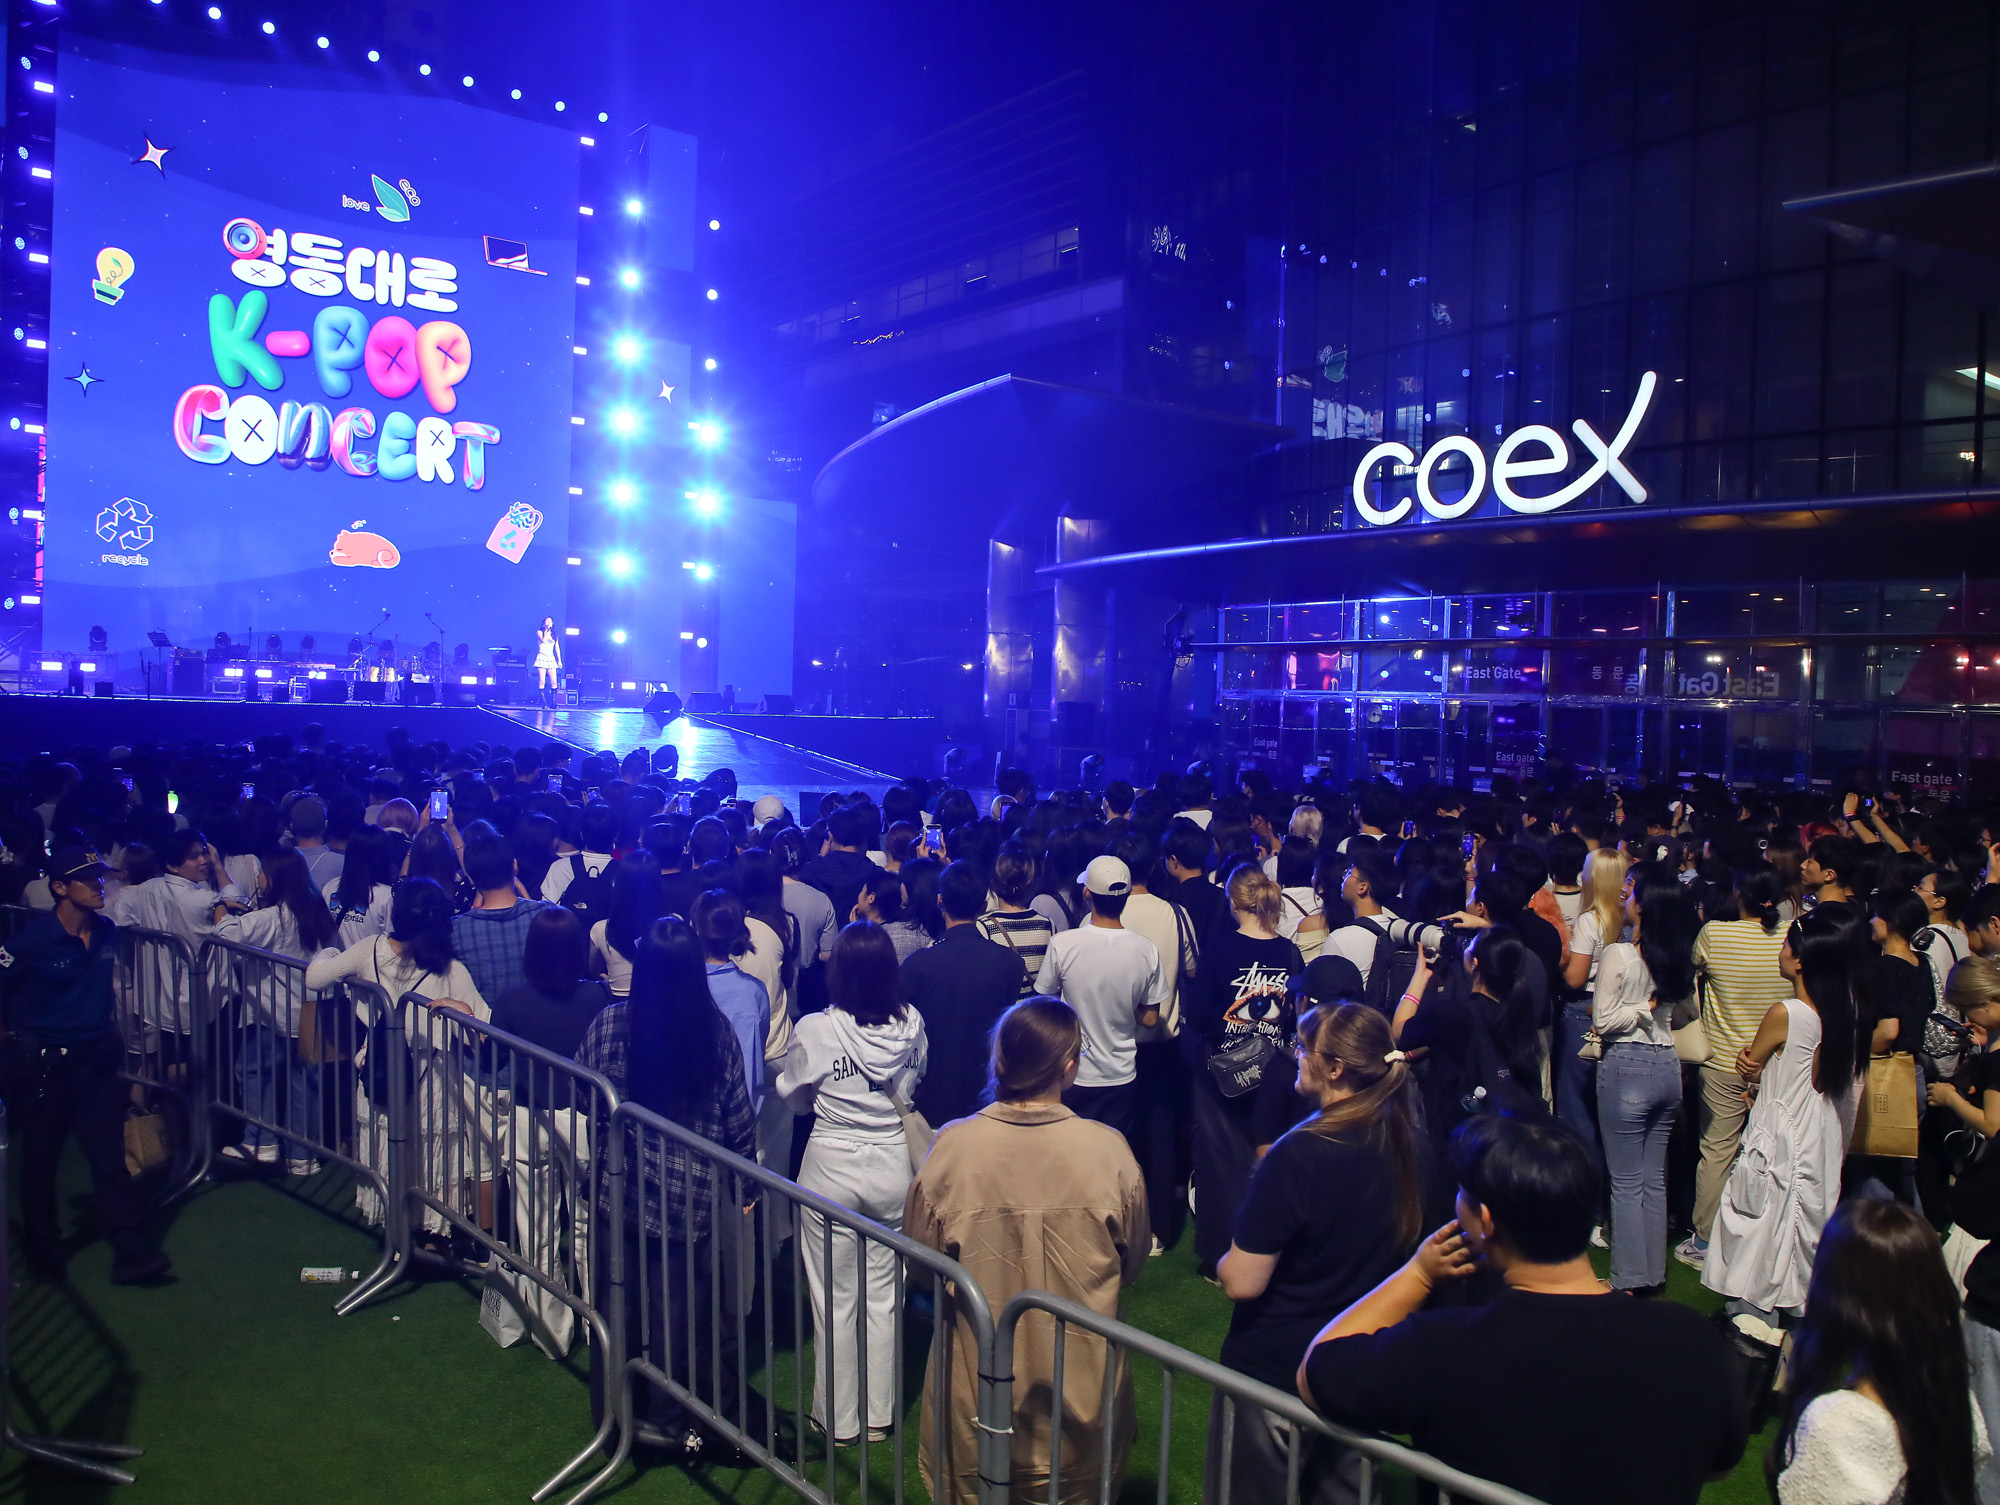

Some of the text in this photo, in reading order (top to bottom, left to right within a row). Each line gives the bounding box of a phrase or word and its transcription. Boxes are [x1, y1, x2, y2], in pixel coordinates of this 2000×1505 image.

[399, 178, 421, 207] eco
[342, 194, 371, 212] love
[222, 217, 459, 313] 영동대로
[208, 290, 472, 414] K-POP
[173, 384, 501, 491] CONCERT
[1353, 371, 1657, 526] coex
[101, 553, 149, 567] recycle
[1466, 666, 1521, 679] East Gate
[1253, 737, 1266, 747] East
[1495, 751, 1535, 765] East gate
[1923, 774, 1953, 787] gate
